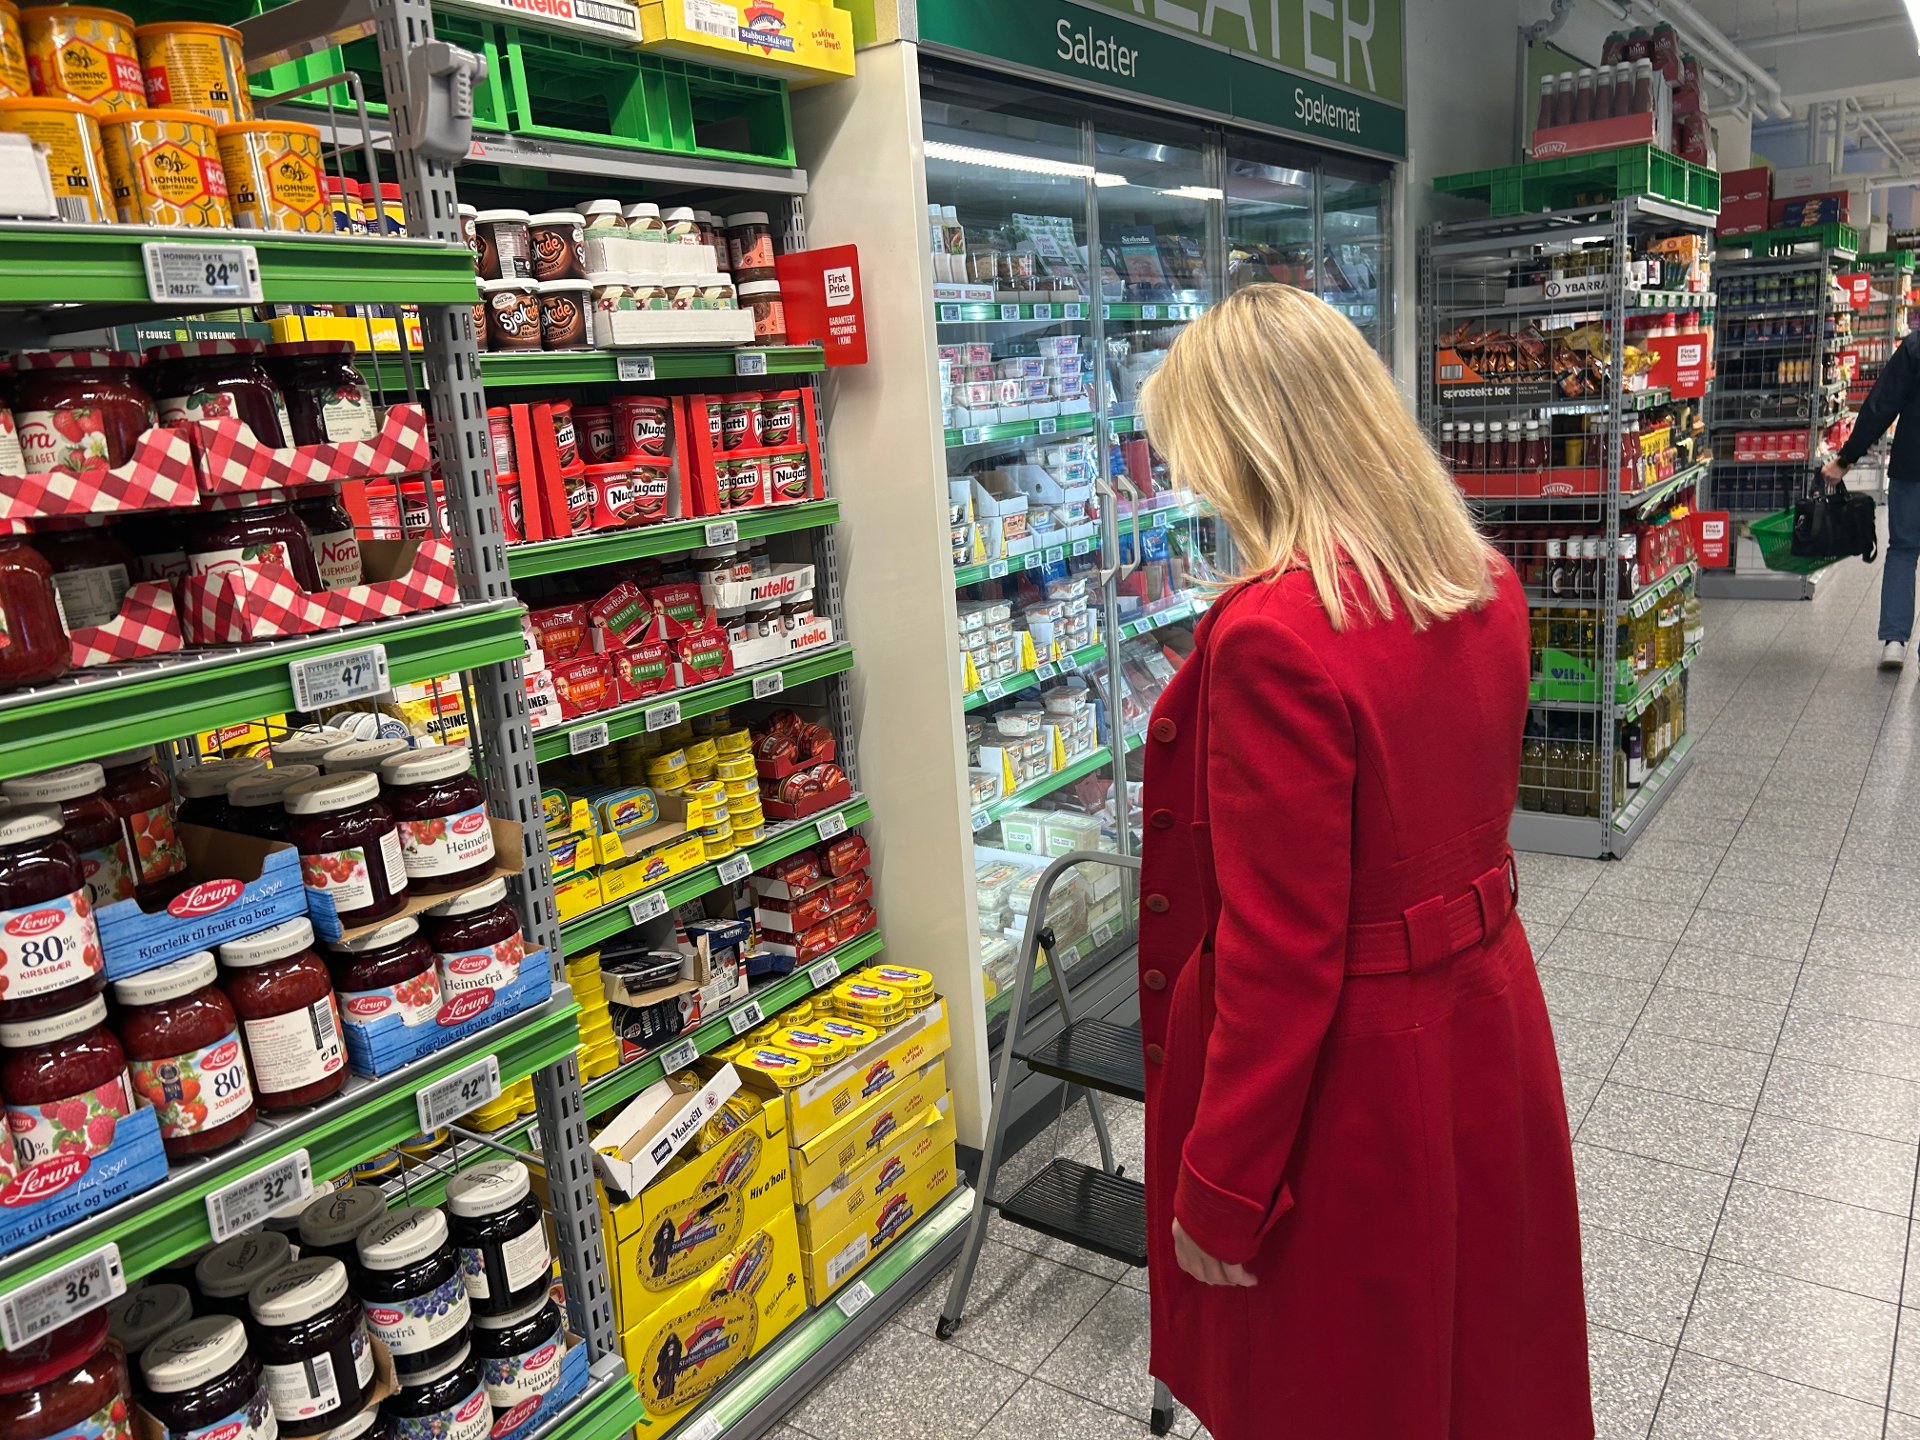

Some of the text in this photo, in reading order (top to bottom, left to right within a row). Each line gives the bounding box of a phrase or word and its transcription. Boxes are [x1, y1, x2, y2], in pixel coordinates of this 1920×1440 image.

[1056, 18, 1139, 78] Salater
[1294, 88, 1361, 135] Spekemat
[1537, 144, 1565, 155] HEINZ
[150, 175, 199, 187] HONNING
[276, 184, 317, 193] HONNING
[205, 263, 229, 286] 84
[827, 273, 847, 284] First
[829, 283, 850, 294] Price
[1564, 280, 1609, 294] YBARRA
[146, 330, 172, 340] COURSE
[195, 330, 236, 341] IT'S ORGANIC
[721, 417, 745, 433] gatti
[762, 414, 791, 430] ugatti
[20, 433, 57, 449] ora
[25, 451, 57, 465] ELAGET
[603, 473, 628, 483] ORIGINAL
[633, 480, 666, 497] ugatti
[405, 511, 427, 526] atti
[317, 538, 359, 566] Nora
[320, 560, 362, 577] HJEMMELAGET
[750, 575, 796, 601] nutella
[791, 628, 827, 650] nutella
[341, 664, 362, 687] 47
[432, 701, 459, 714] ELORADO
[454, 815, 484, 833] Lerum
[446, 829, 492, 855] Heimefrå
[172, 884, 238, 915] Lerum
[15, 911, 61, 933] Lerum
[138, 904, 277, 961] Kjærleik til frukt og bær
[20, 934, 77, 969] 80%
[19, 960, 73, 981] KIRSEBÆR
[454, 956, 488, 973] Lerum
[444, 970, 503, 992] Heimefrå
[350, 998, 387, 1014] Lerum
[440, 994, 490, 1025] Lerum
[415, 1002, 521, 1057] Kjærleik til frukt og bær
[208, 1044, 238, 1066] Lerum
[214, 1088, 246, 1111] JORDBÆR
[461, 1078, 479, 1101] 42
[4, 1160, 82, 1205] Lerum
[263, 1177, 284, 1203] 32
[750, 1185, 763, 1200] Hiv
[28, 1180, 129, 1230] til frukt og bær
[65, 1277, 90, 1304] 36
[371, 1309, 399, 1324] Lerum
[530, 1347, 555, 1370] Lerum
[492, 1399, 538, 1439] Lerum
